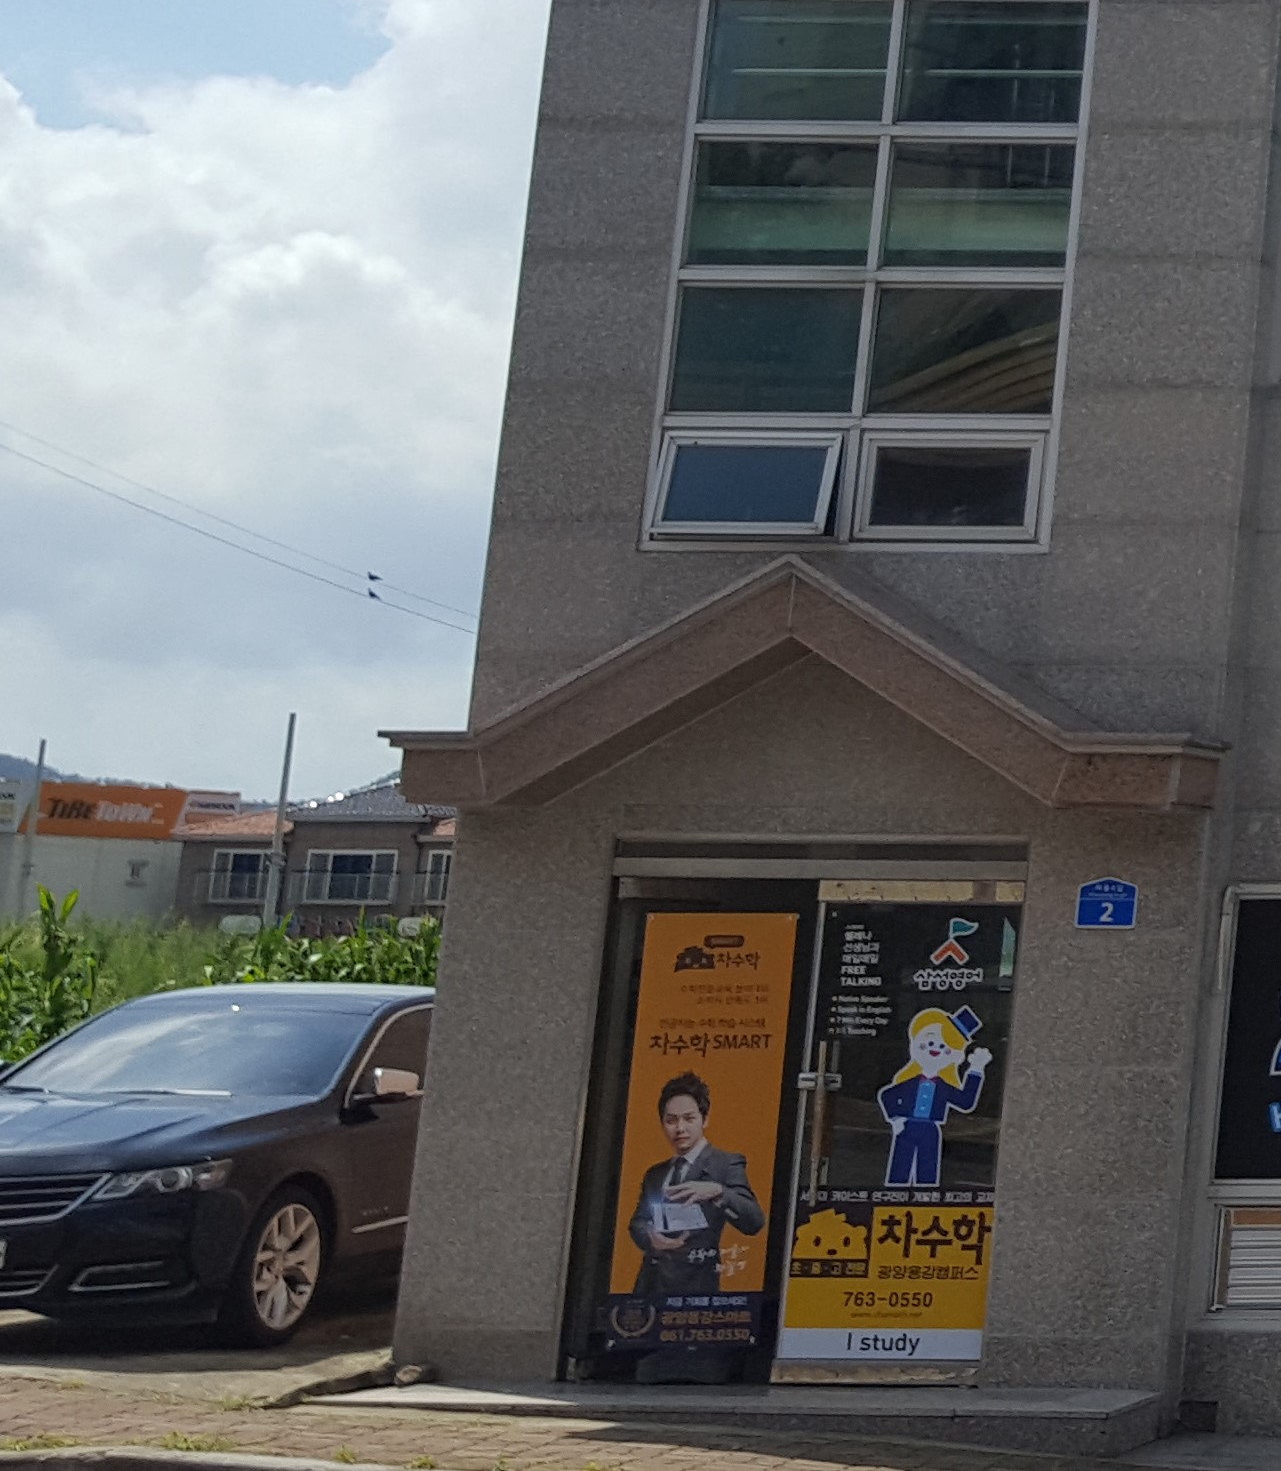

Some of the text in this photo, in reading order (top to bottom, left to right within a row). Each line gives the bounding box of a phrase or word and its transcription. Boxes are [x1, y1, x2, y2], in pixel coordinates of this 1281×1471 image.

[1099, 901, 1114, 922] 2
[840, 965, 867, 975] FREE
[839, 977, 883, 987] TALKING
[913, 968, 984, 991] 삼성영어
[713, 1033, 773, 1050] SMART
[877, 1210, 993, 1265] 차수학
[877, 1265, 979, 1280] 광양용강캠퍼스
[842, 1291, 933, 1307] 763-0550
[859, 1333, 921, 1355] study
